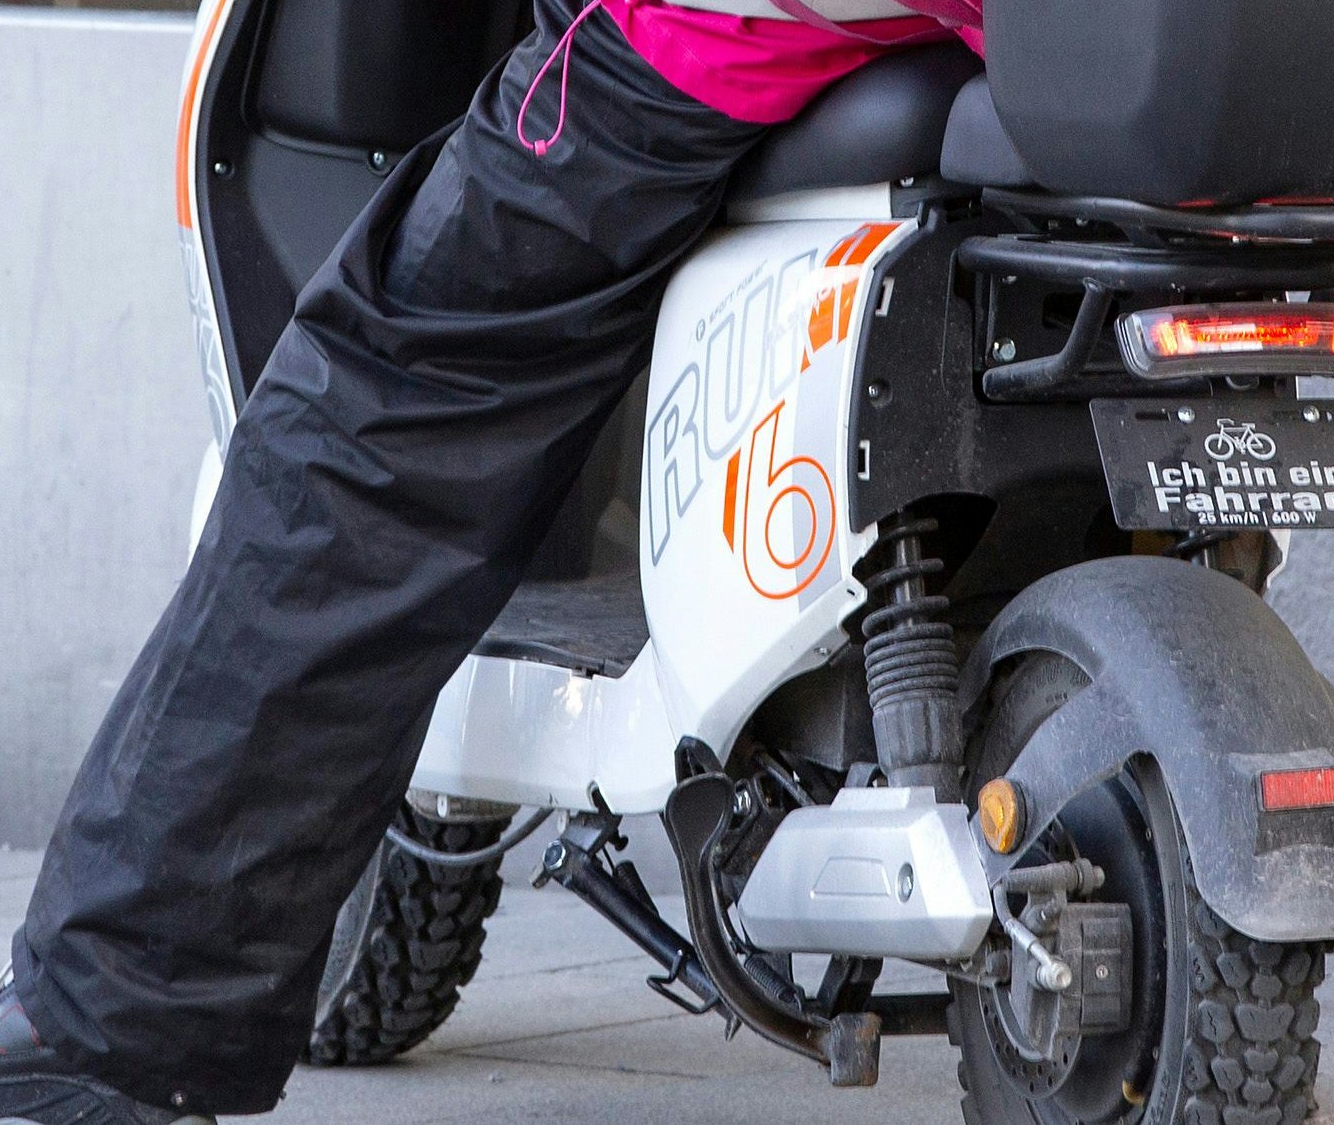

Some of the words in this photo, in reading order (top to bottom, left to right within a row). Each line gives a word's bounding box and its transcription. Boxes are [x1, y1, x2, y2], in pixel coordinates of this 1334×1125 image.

[1146, 461, 1207, 487] Ich
[1216, 461, 1277, 487] bin
[1198, 512, 1216, 525] 25
[1219, 511, 1259, 525] km/h
[1271, 511, 1300, 525] 600
[1304, 511, 1316, 525] W
